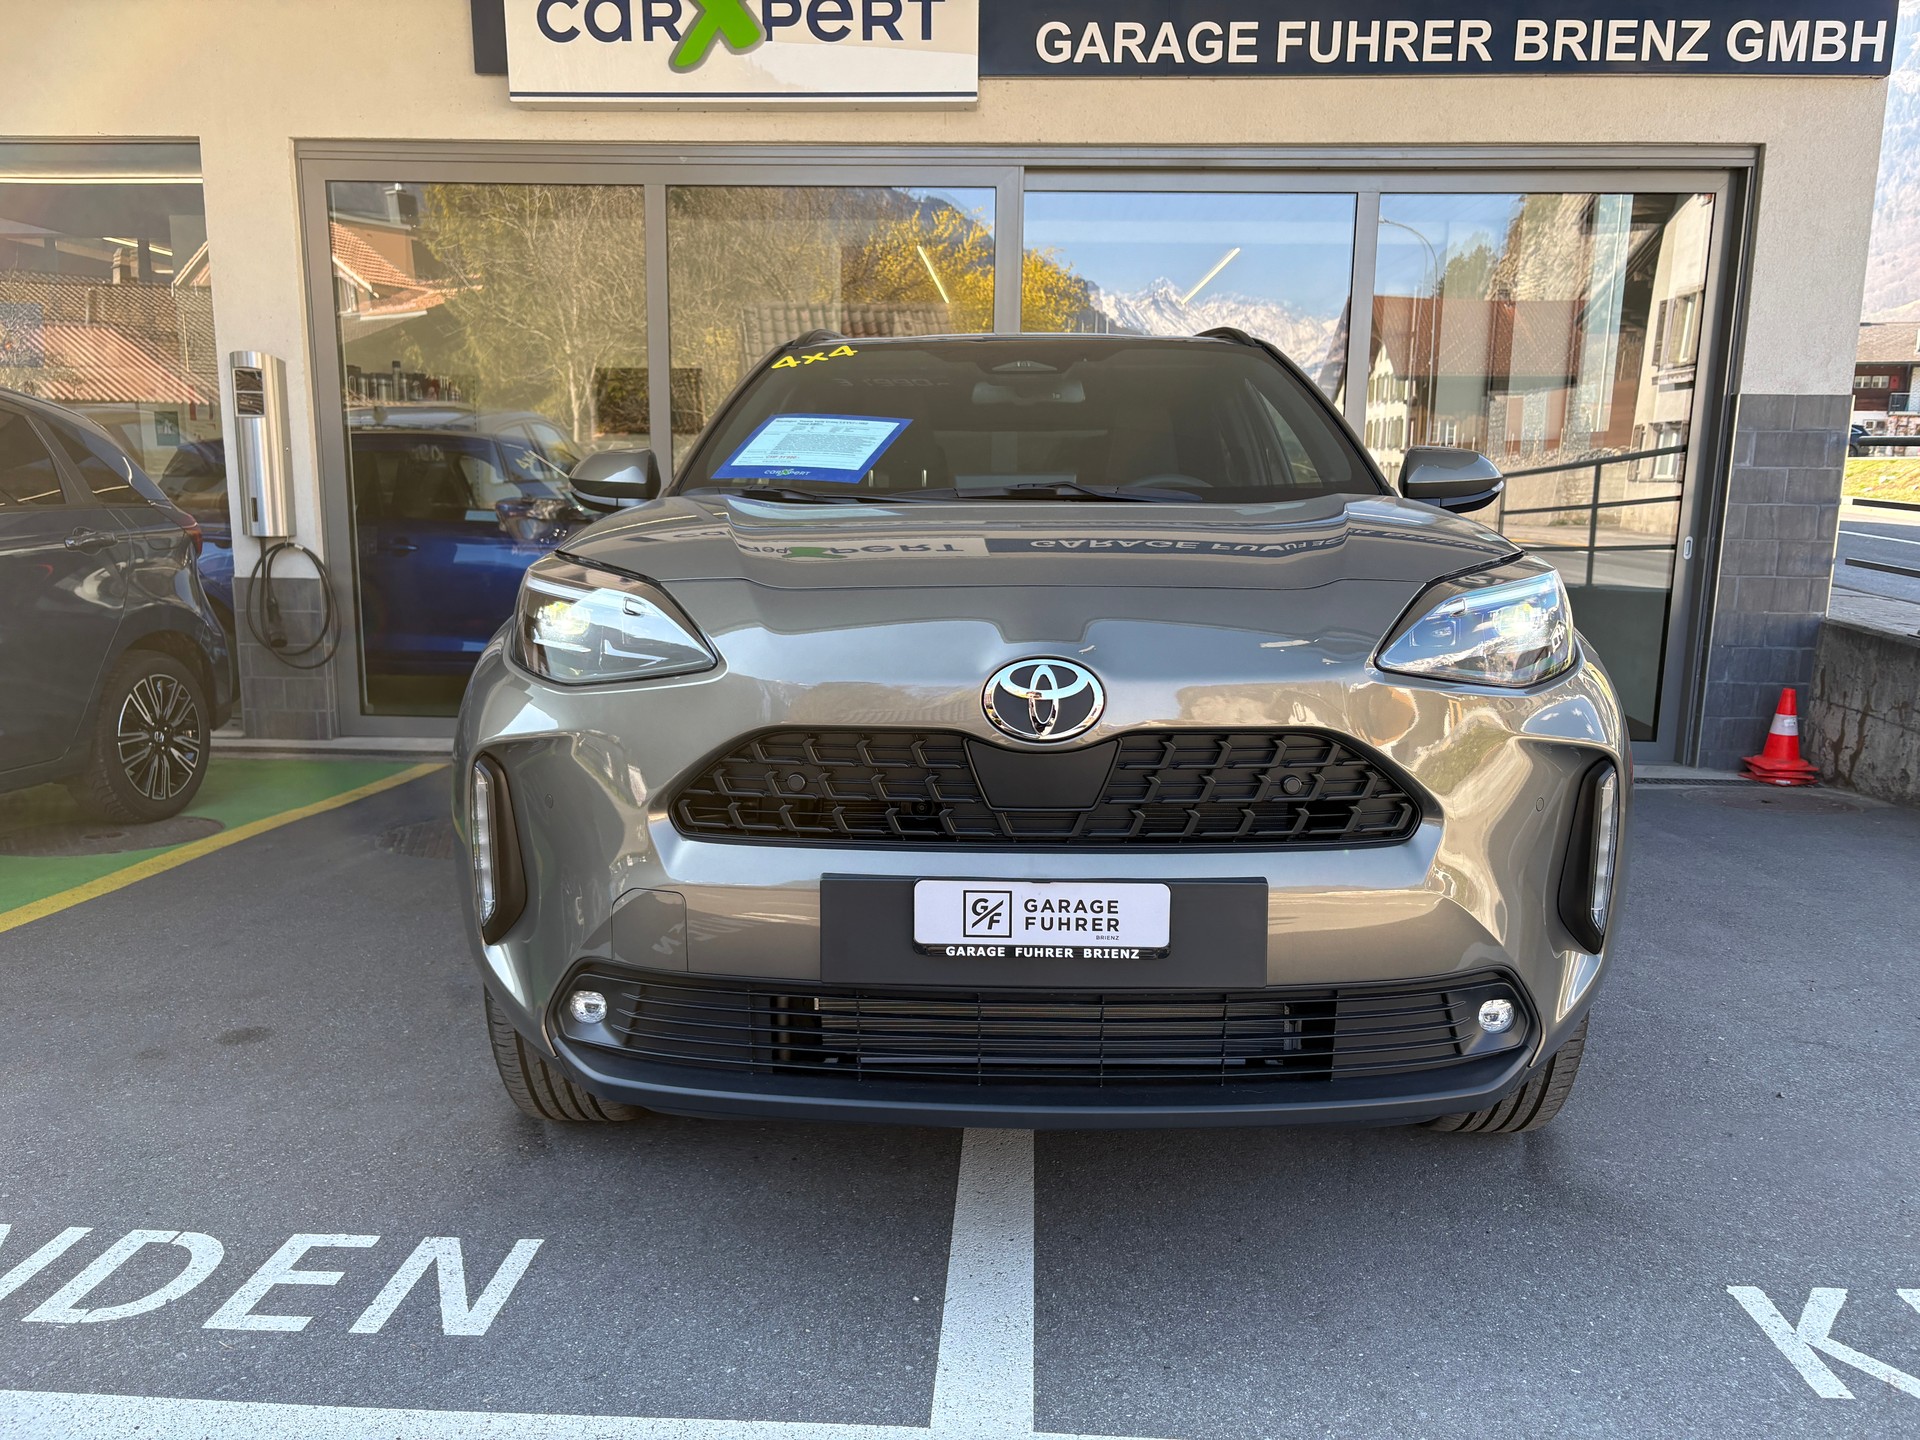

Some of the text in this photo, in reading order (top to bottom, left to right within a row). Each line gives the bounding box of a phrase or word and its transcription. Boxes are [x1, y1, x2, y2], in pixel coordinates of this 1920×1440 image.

[1035, 19, 1888, 64] GARAGE FUHRER BRIENZ GMBH
[1023, 898, 1119, 914] GARAGE
[1025, 917, 1120, 932] FUHRER
[945, 946, 1140, 959] GARAGE FUHRER BRIENZ
[0, 1223, 545, 1336] DEN
